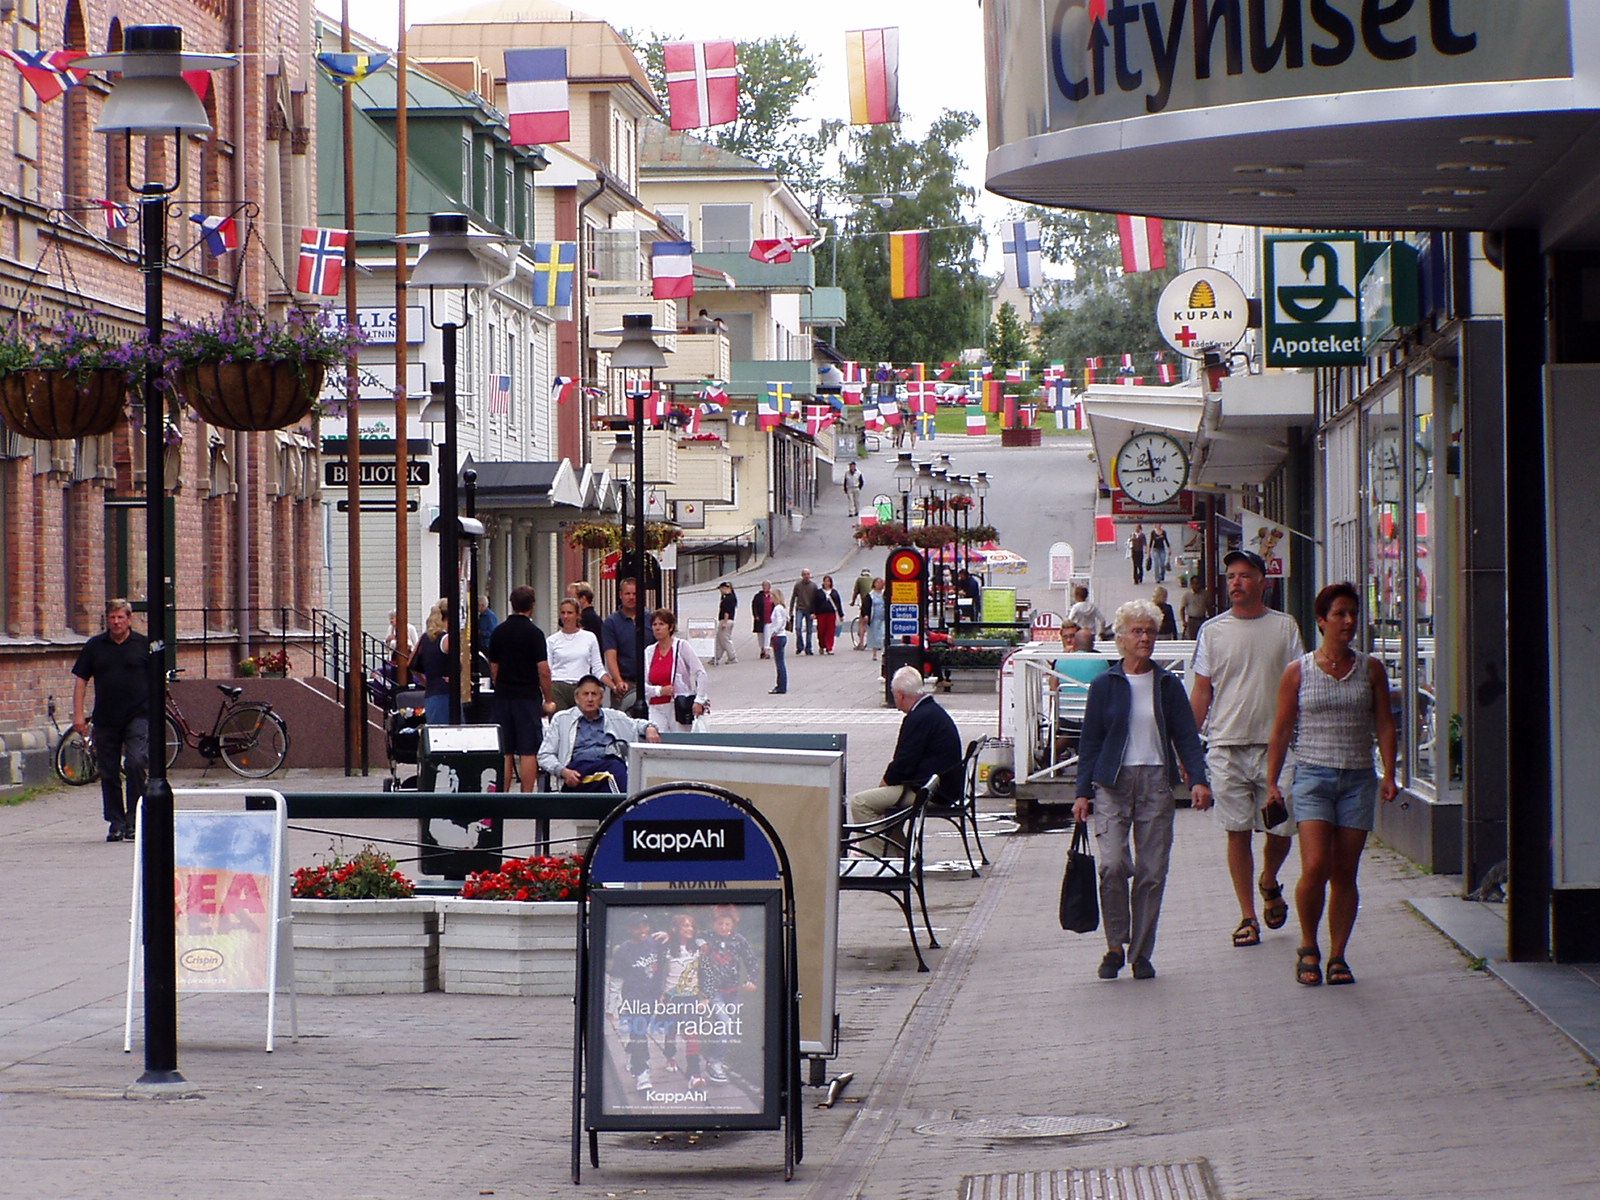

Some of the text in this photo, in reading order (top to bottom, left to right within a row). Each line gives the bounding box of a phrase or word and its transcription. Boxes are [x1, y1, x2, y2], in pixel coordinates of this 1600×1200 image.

[1173, 310, 1233, 320] KUPAN
[1272, 334, 1361, 358] Apoteket
[333, 465, 422, 482] BILIOTK
[632, 829, 725, 853] KappAhl
[175, 873, 267, 915] EA
[185, 953, 219, 968] Crispin
[619, 1000, 744, 1019] Alla barnbyxor
[676, 1017, 743, 1036] rabatt
[646, 1090, 707, 1104] KappAhl
